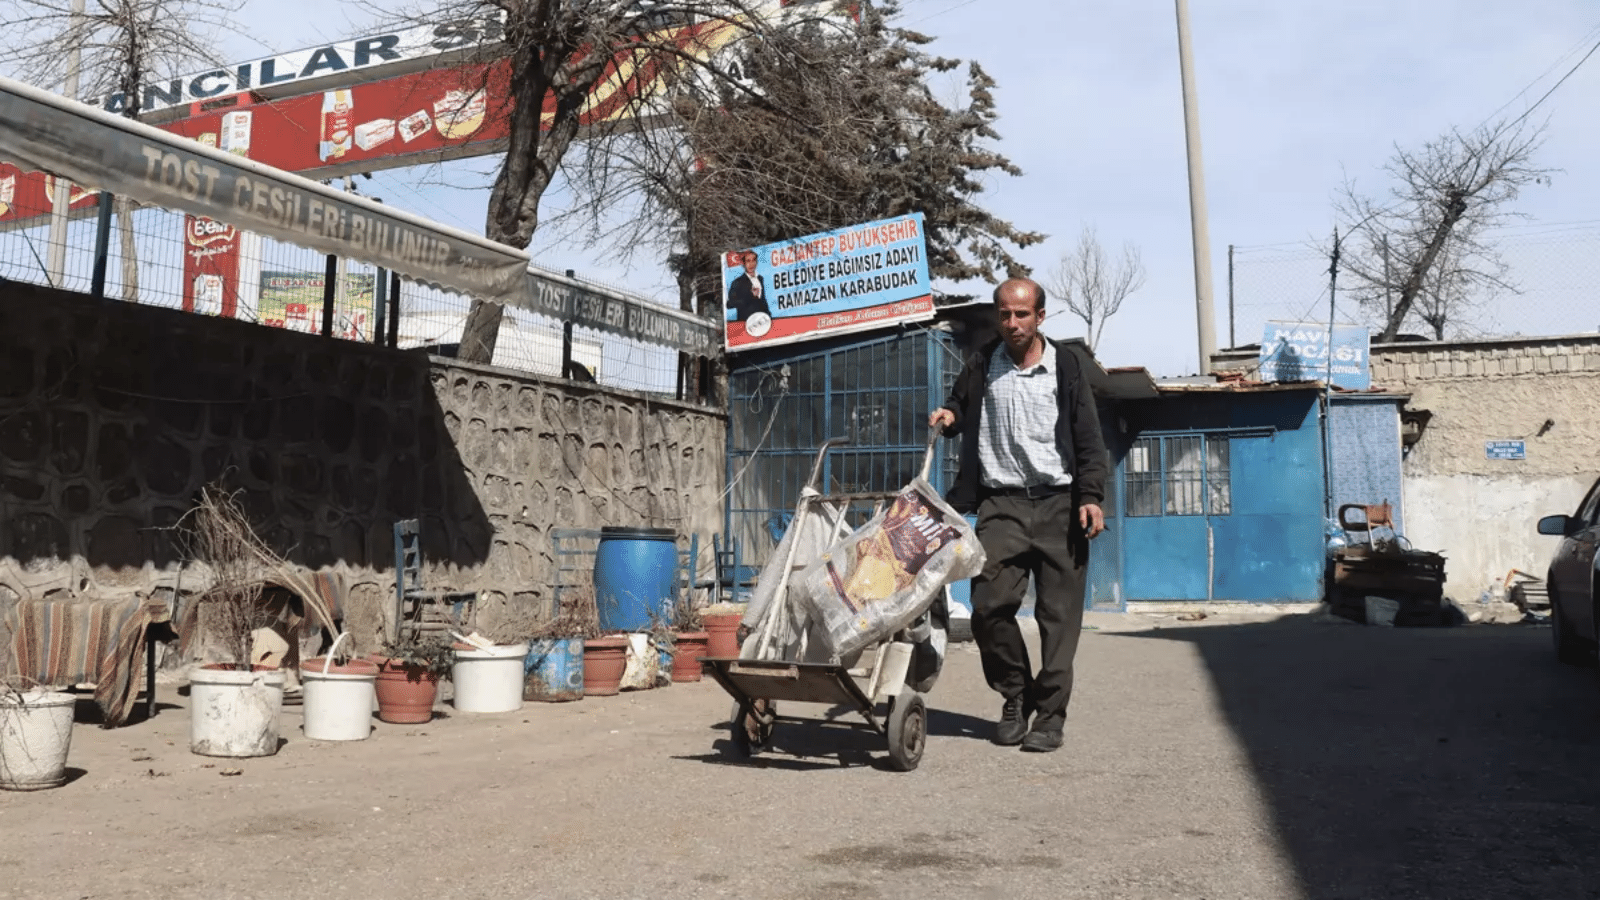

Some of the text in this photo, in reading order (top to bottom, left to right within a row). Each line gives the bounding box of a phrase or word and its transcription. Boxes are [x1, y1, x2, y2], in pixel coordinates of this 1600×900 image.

[88, 34, 399, 113] ANCILAR
[143, 146, 221, 206] TOST
[350, 213, 450, 275] BULUNUR
[778, 268, 918, 310] RAMAZAN KARABUDAK
[828, 252, 883, 279] BAĞIMSIZ
[885, 244, 919, 268] ADAYI
[536, 281, 571, 313] TOST
[628, 306, 680, 342] BULUNUR
